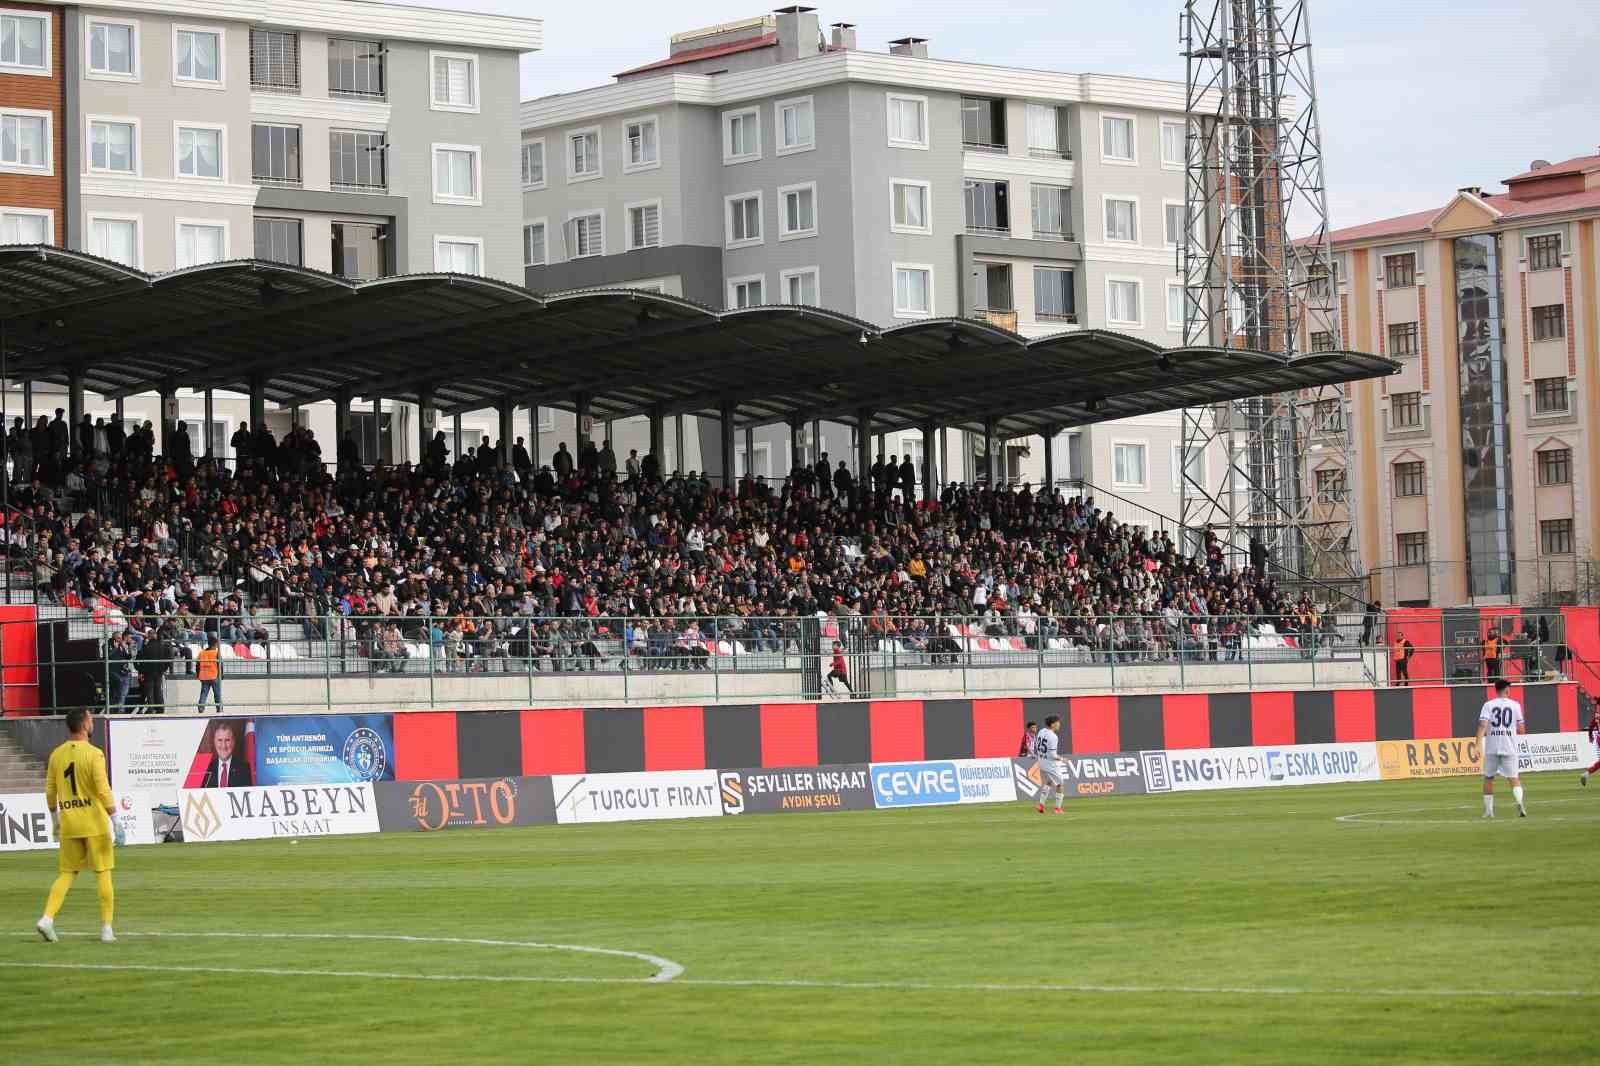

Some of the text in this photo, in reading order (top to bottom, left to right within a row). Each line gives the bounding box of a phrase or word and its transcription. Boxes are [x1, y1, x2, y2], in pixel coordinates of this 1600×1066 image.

[1491, 706, 1513, 728] 30
[1285, 751, 1320, 776] ESKA
[1322, 750, 1358, 775] GRUP
[63, 761, 78, 797] 1
[747, 771, 867, 797] ŞEVLİLER İNŞAAT
[876, 769, 956, 802] ÇEVRE
[1077, 781, 1115, 794] GROUP
[226, 786, 368, 819] MABEYN
[588, 787, 660, 811] TURGUT
[782, 793, 841, 809] AYDIN ŞEVLİ
